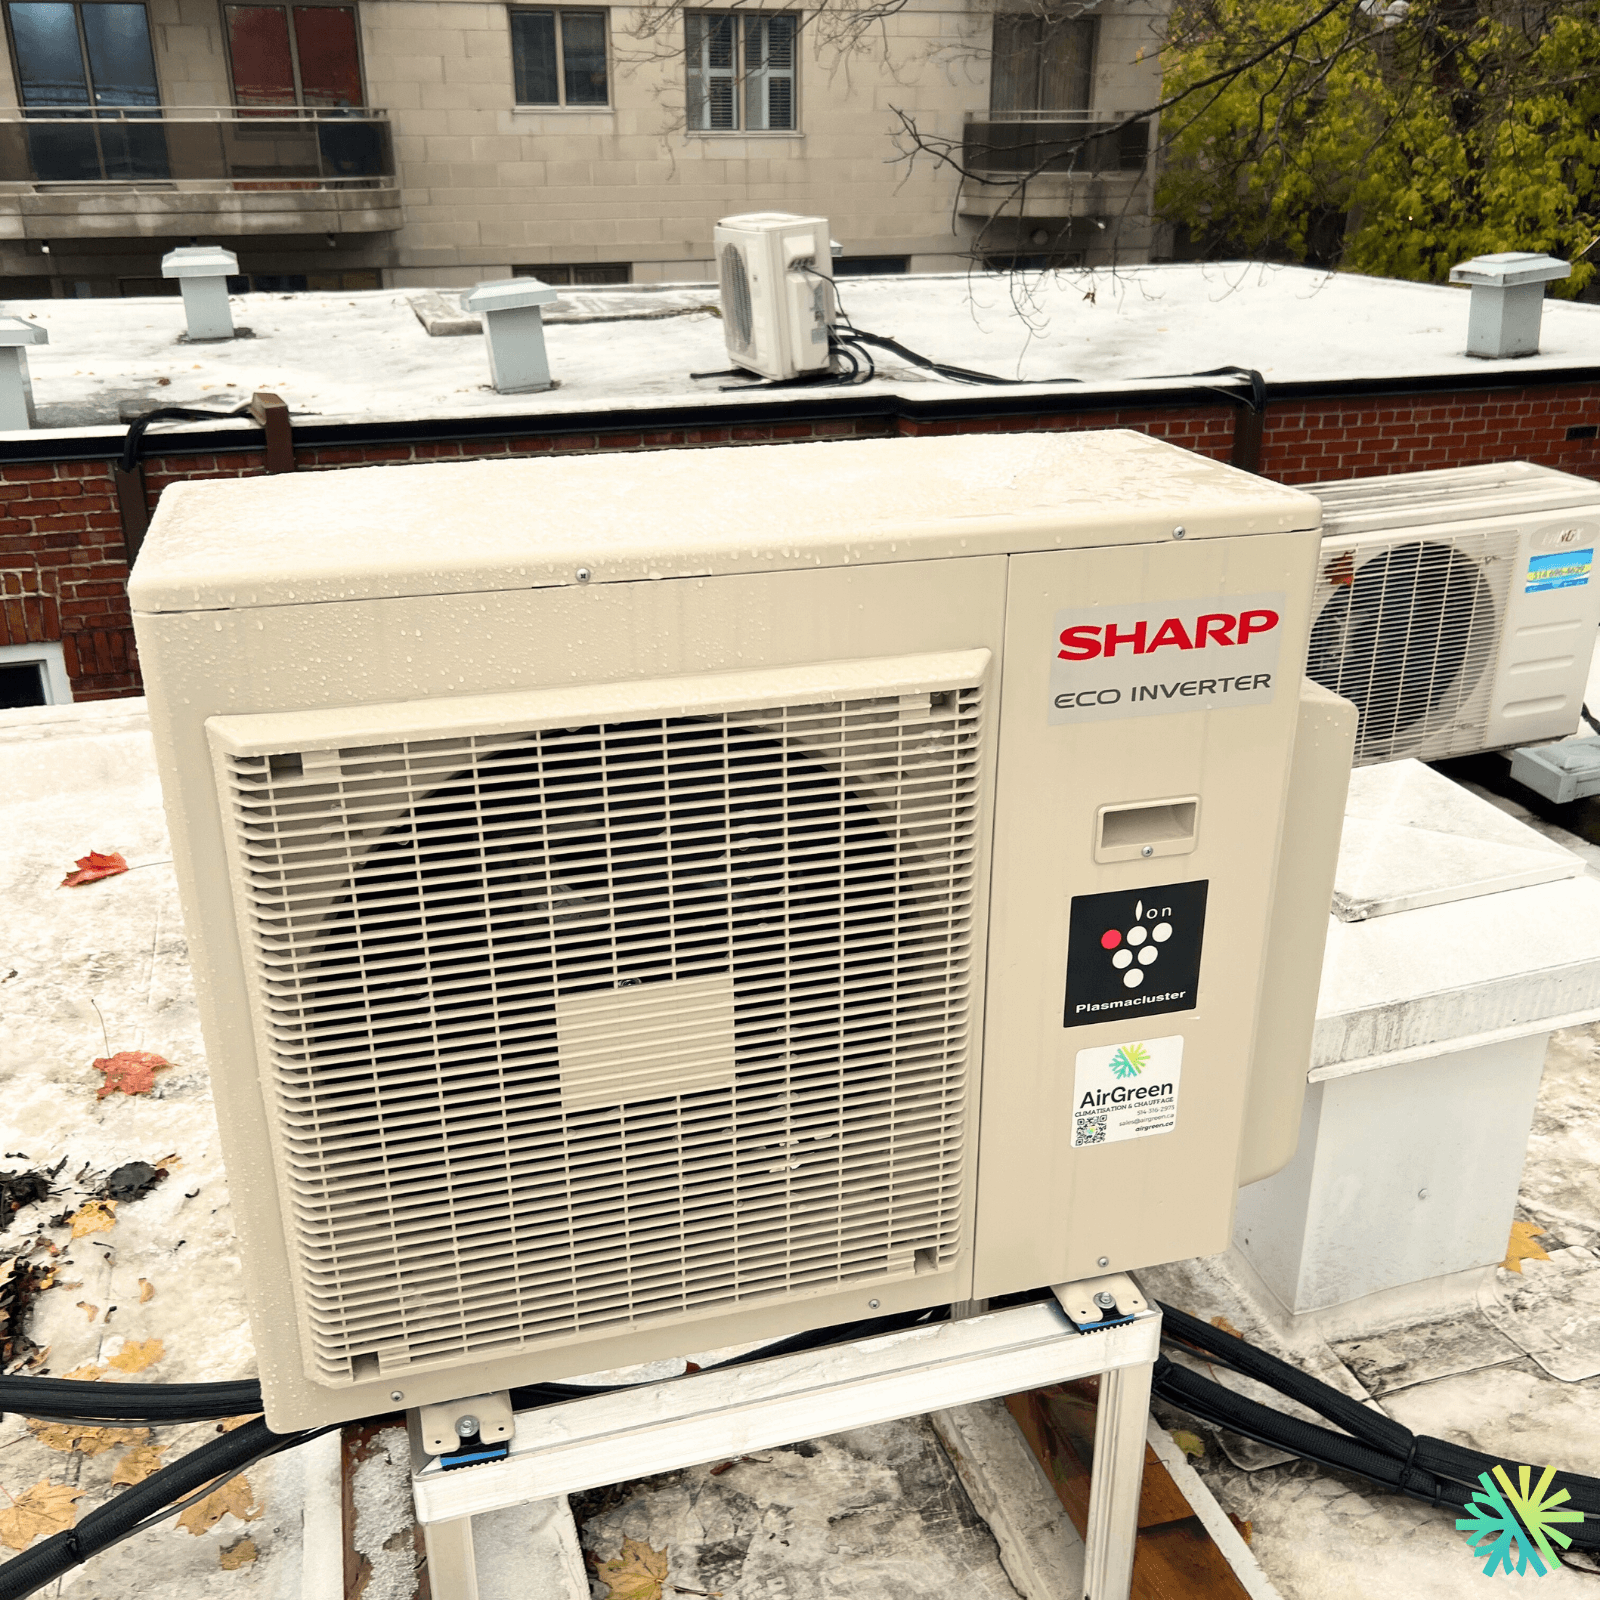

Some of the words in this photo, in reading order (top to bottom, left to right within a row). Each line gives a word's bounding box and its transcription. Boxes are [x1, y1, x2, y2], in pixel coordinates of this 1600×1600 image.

[1057, 609, 1280, 661] SHARP
[1054, 688, 1121, 709] ECO
[1130, 673, 1272, 702] INVERTER
[1075, 990, 1187, 1014] Plasmacluster
[1074, 1104, 1127, 1118] CLIMATISATION
[1133, 1096, 1174, 1109] CHAUFFAGE
[1079, 1082, 1173, 1109] AirGreen
[1119, 1113, 1174, 1127] sales@airgreen.ca
[1135, 1121, 1174, 1132] airgreen.ca
